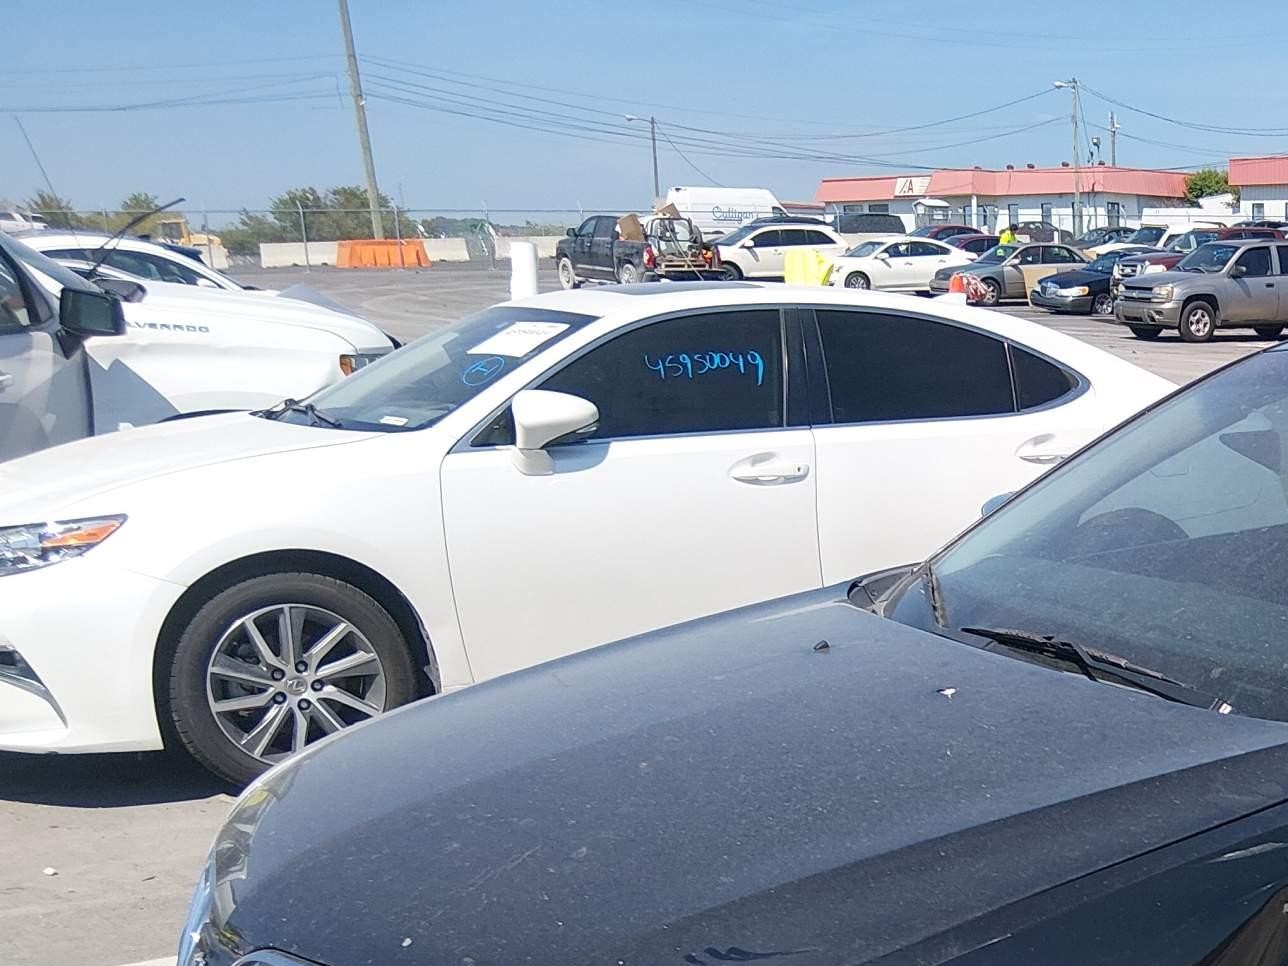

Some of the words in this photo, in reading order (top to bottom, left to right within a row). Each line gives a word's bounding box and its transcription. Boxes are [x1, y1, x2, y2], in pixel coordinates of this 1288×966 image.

[712, 205, 754, 224] Culligan
[124, 320, 210, 333] LVERADO
[644, 351, 764, 385] 45950049
